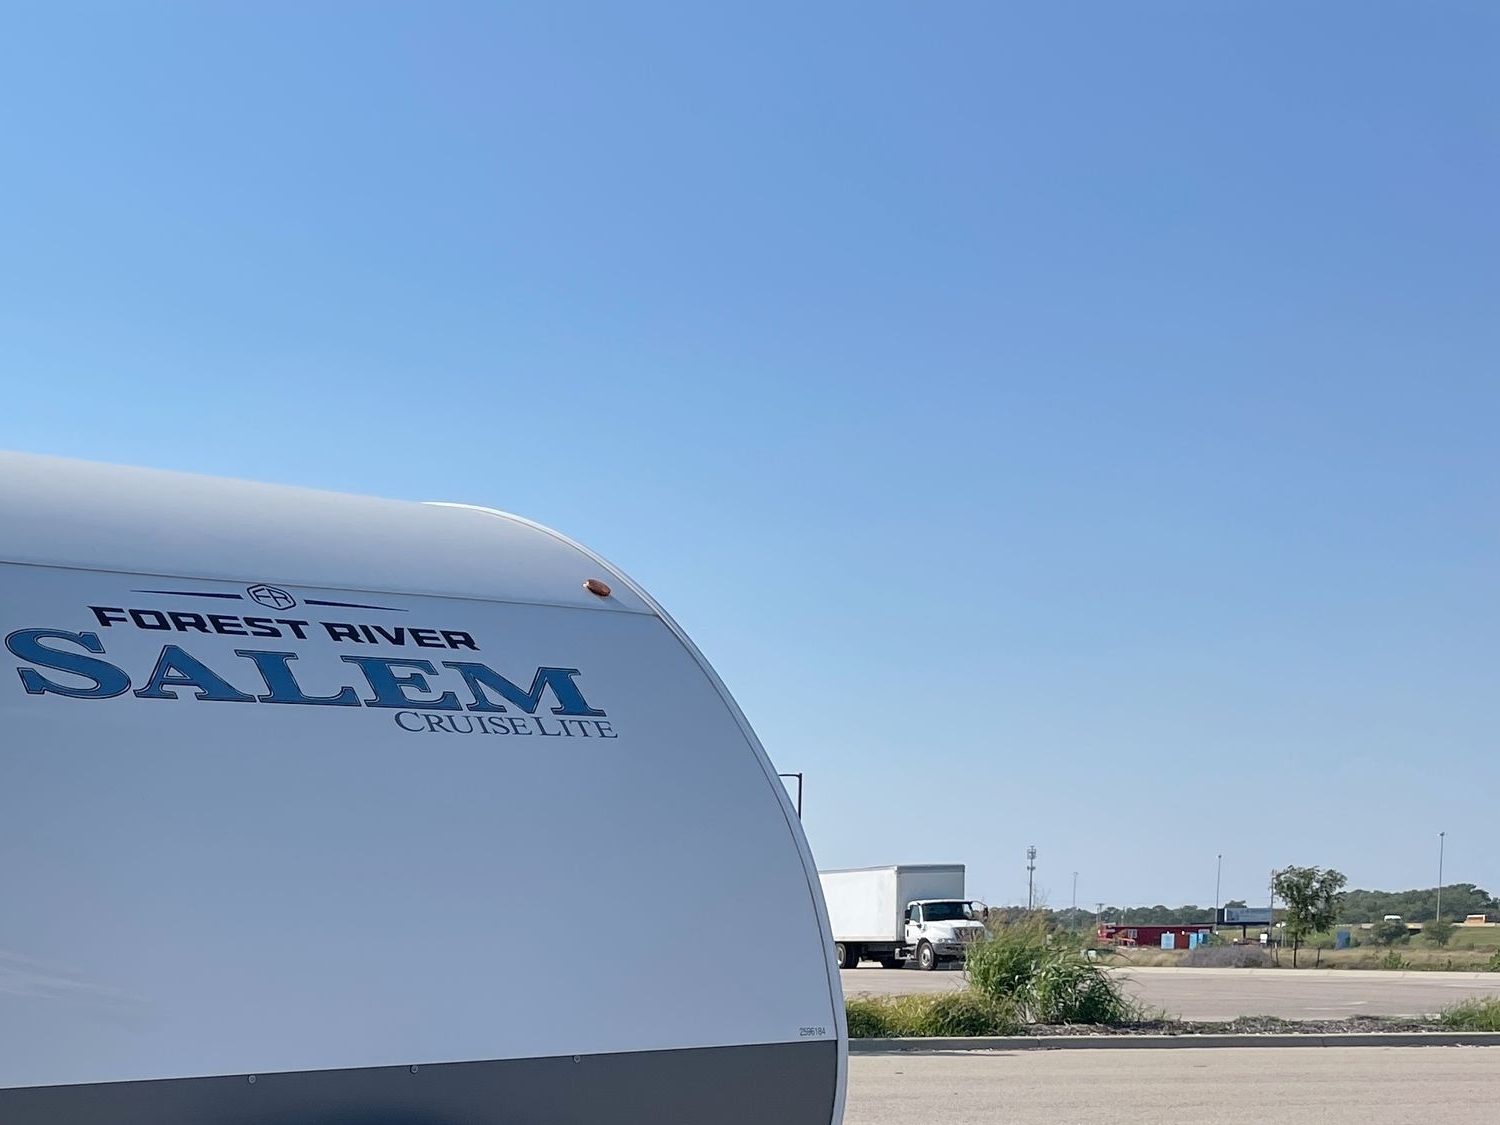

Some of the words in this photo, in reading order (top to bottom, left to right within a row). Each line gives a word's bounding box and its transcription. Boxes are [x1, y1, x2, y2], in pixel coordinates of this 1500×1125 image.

[86, 605, 310, 640] FOREST
[319, 621, 482, 651] RIVER
[4, 626, 607, 718] SALEM
